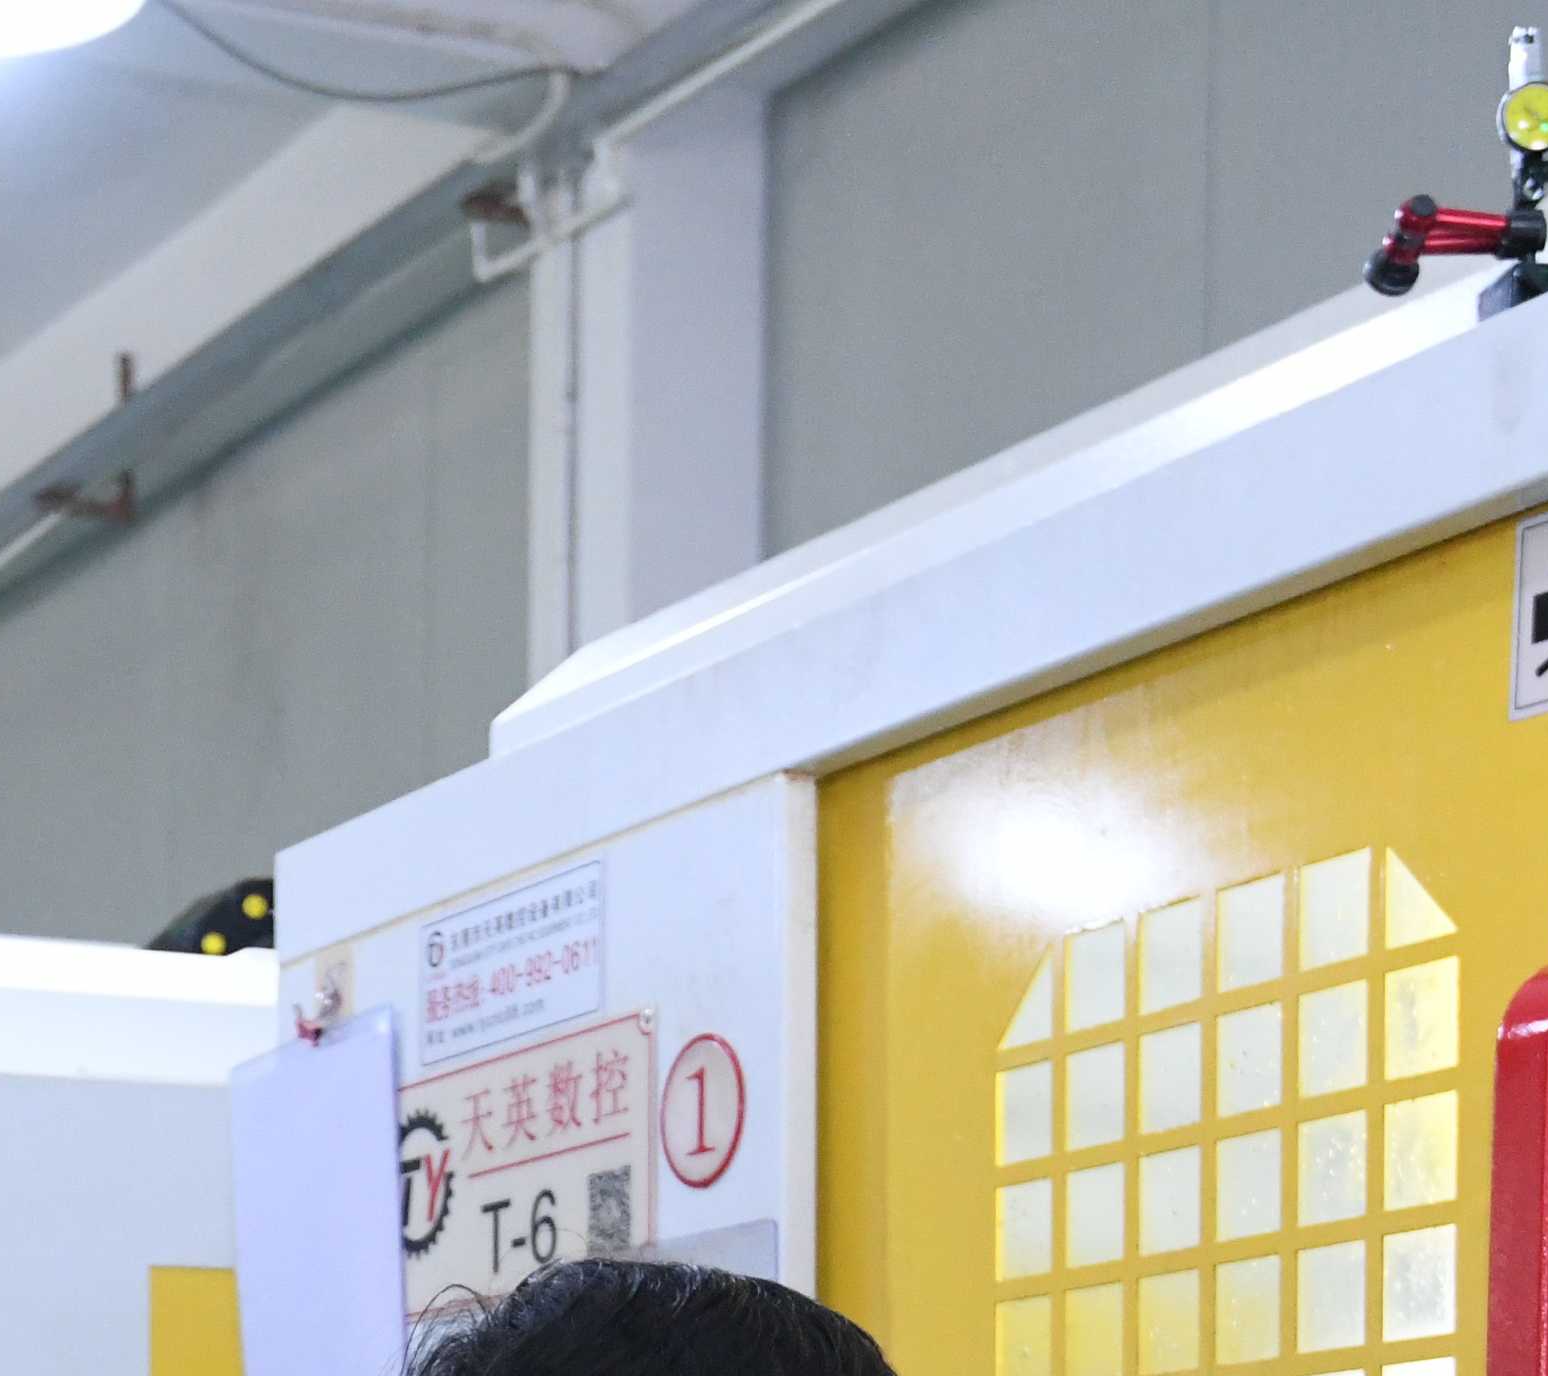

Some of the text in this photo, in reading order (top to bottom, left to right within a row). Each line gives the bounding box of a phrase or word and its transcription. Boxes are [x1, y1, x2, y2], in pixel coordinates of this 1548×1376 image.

[460, 1048, 631, 1162] 天英数控
[481, 1189, 557, 1273] T-6
